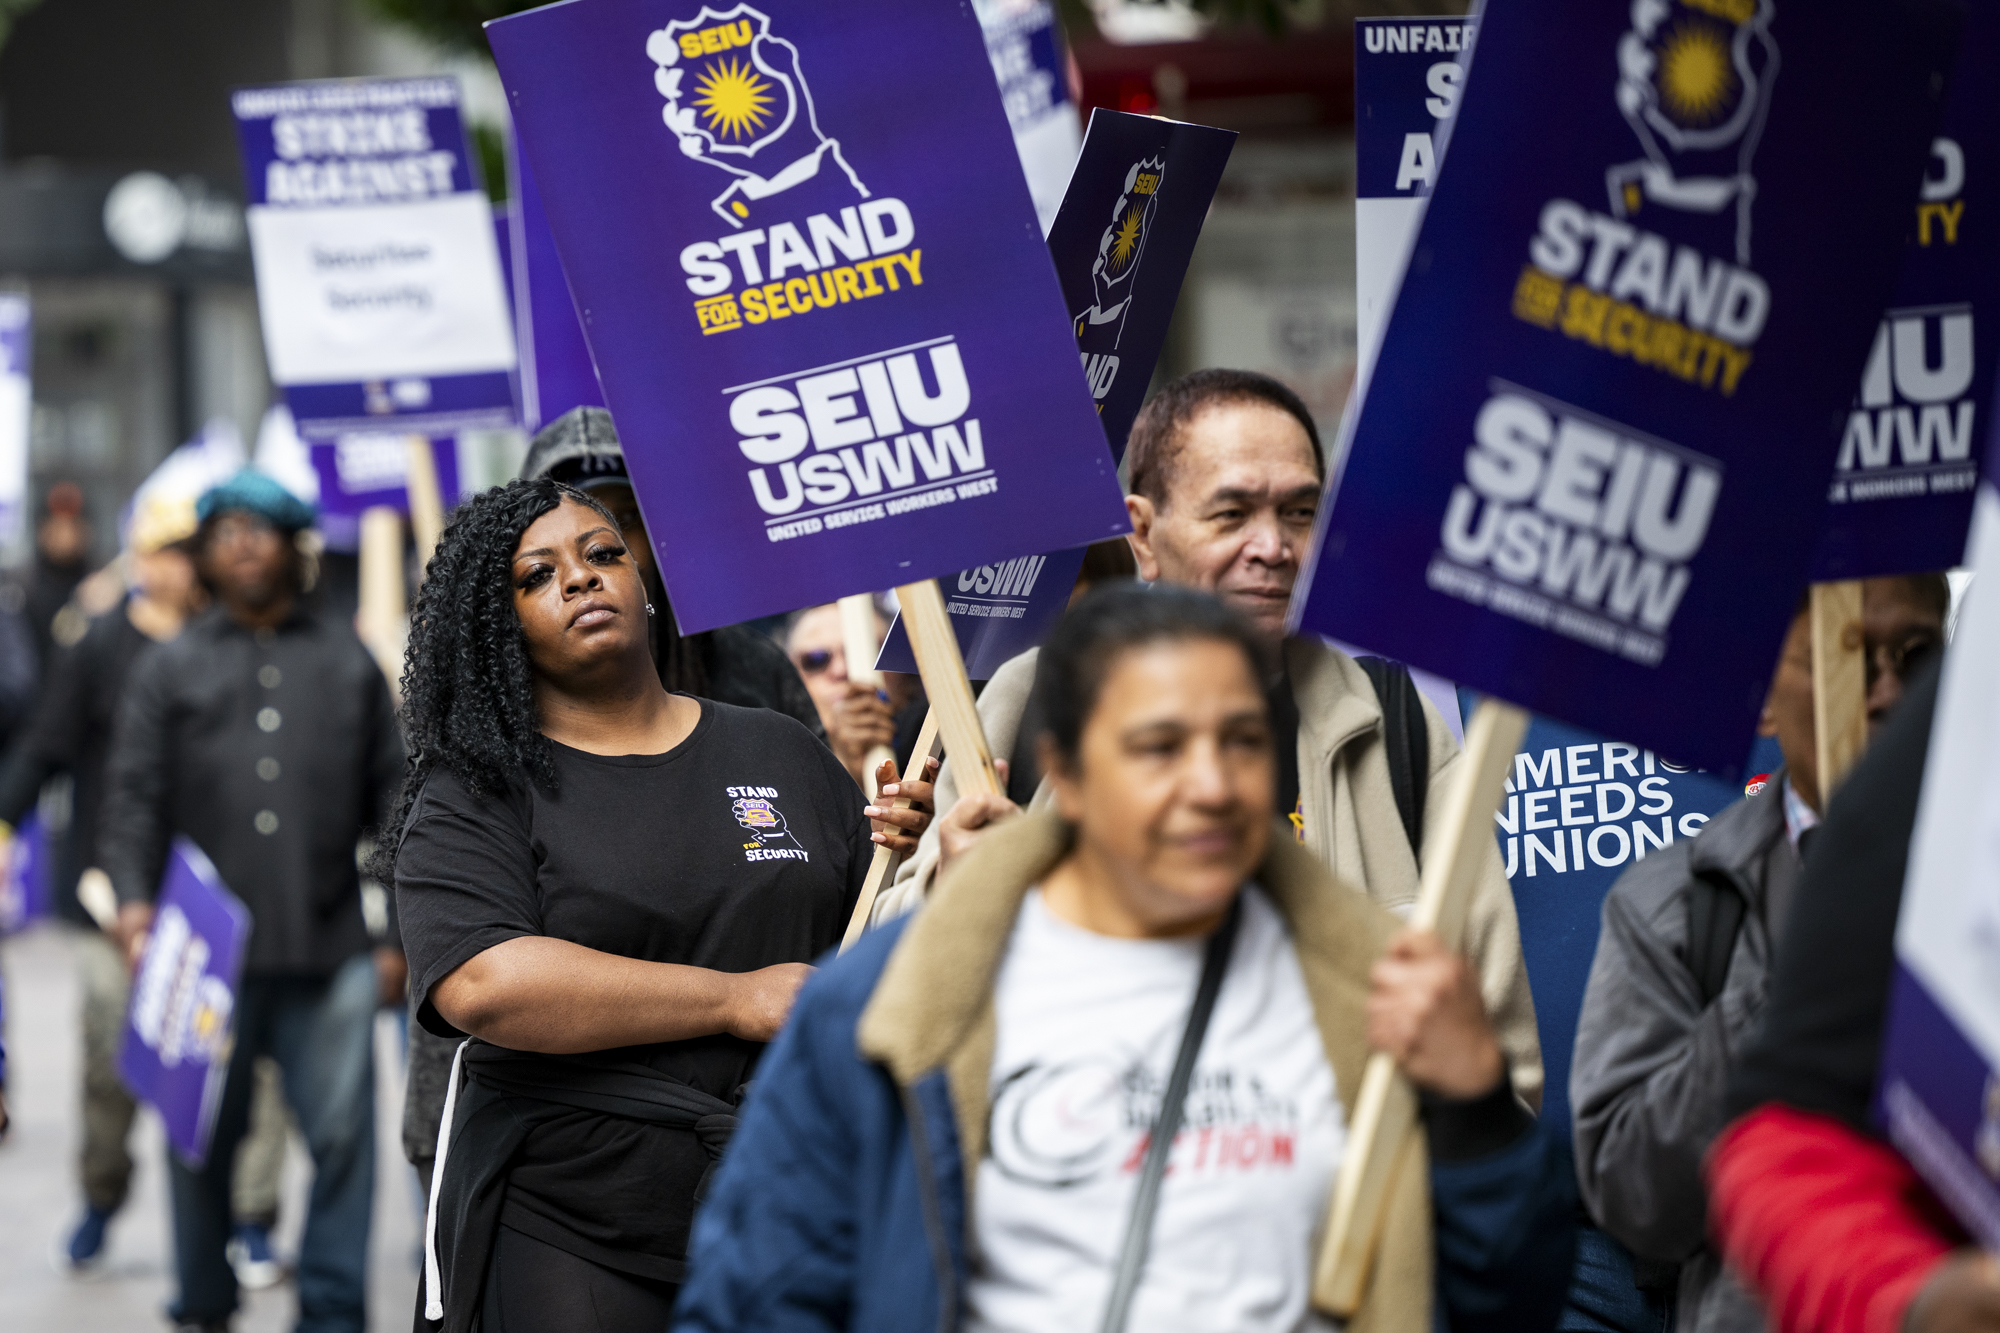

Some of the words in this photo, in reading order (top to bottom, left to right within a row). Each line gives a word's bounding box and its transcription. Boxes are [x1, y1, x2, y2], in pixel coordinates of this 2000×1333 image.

[679, 19, 753, 58] SEIU
[1364, 25, 1477, 54] UNFAIR
[271, 107, 432, 160] STRIKE
[265, 150, 457, 204] AGAINST
[1134, 173, 1159, 195] SEIU
[680, 197, 915, 296] STAND
[1529, 198, 1771, 344] STAND
[696, 300, 741, 330] FOR
[740, 249, 923, 325] SECURITY
[1560, 281, 1753, 398] SECURITY
[1860, 314, 1974, 407] IU
[729, 342, 971, 464] SEIU
[1834, 400, 1975, 470] WW
[748, 418, 986, 515] USWW
[1464, 394, 1723, 562] SEIU
[767, 518, 823, 543] UNITED
[824, 503, 886, 530] SERVICE
[885, 487, 957, 516] WORKERS
[956, 477, 998, 500] WEST
[957, 555, 1047, 597] USWW
[1441, 482, 1692, 630] USWW
[946, 602, 969, 615] UNITED
[967, 604, 991, 617] SERVICE
[990, 606, 1012, 618] WORKERS
[1010, 607, 1027, 619] WEST
[726, 786, 779, 798] STAND
[1502, 742, 1707, 793] MERI
[1493, 777, 1673, 835] NEEDS
[743, 841, 761, 850] FOR
[745, 849, 809, 863] SECURITY
[1120, 1125, 1294, 1176] ATION
